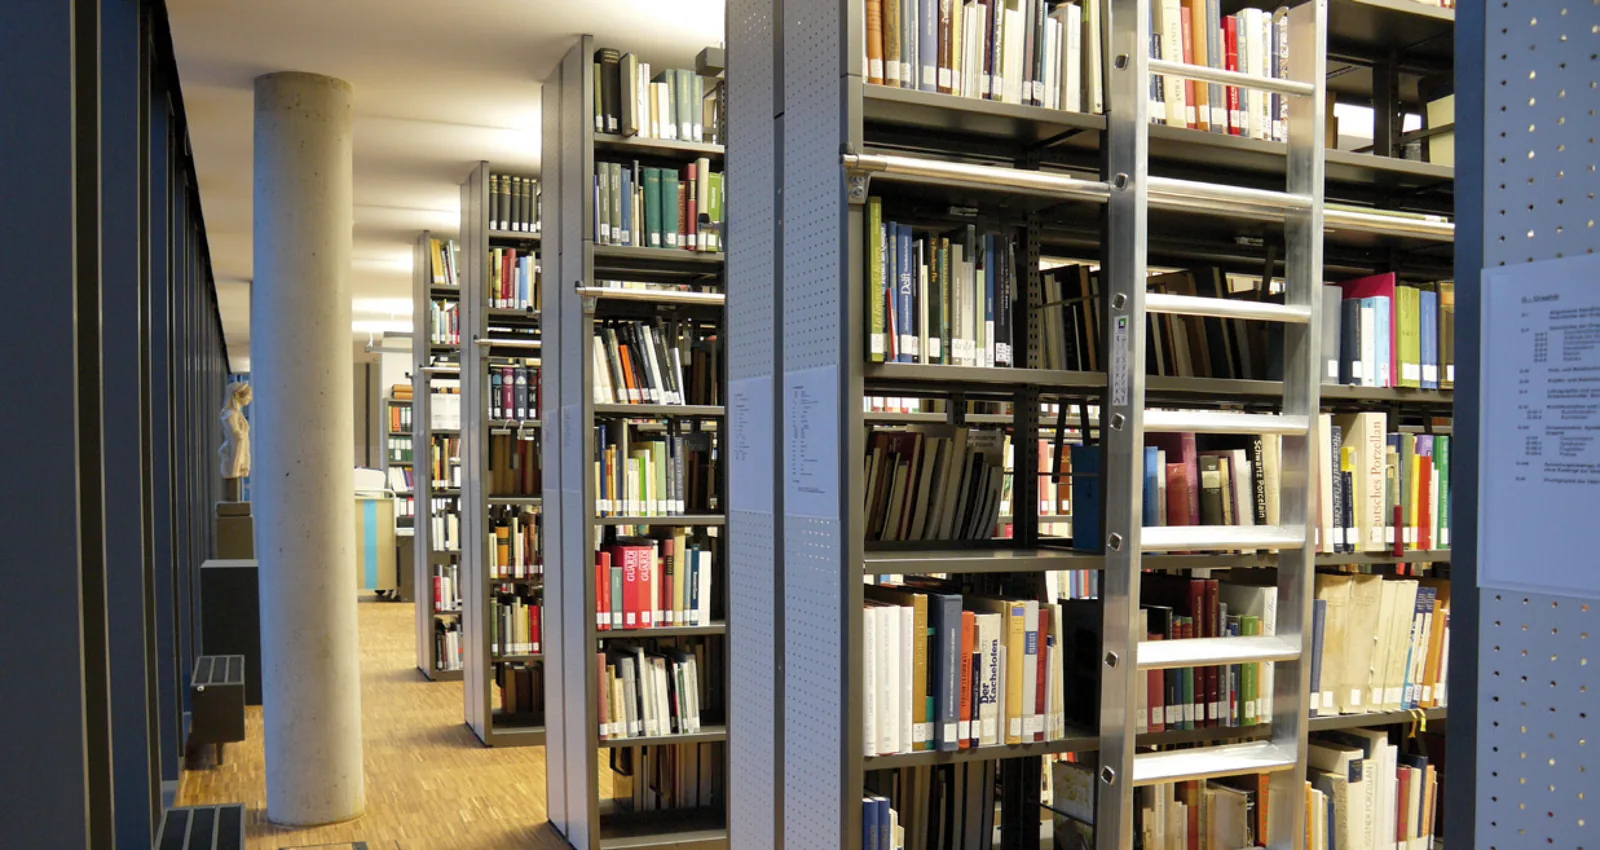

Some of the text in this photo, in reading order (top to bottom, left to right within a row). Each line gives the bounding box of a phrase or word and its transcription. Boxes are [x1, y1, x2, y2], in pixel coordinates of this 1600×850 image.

[900, 272, 911, 295] Delft
[1254, 439, 1266, 519] Schwartz Porcelain
[1370, 420, 1382, 541] eutsches Porzellan
[626, 550, 636, 582] GUARDI
[640, 550, 650, 582] GUARDI
[989, 638, 998, 704] Kachelofen
[979, 682, 989, 704] Der
